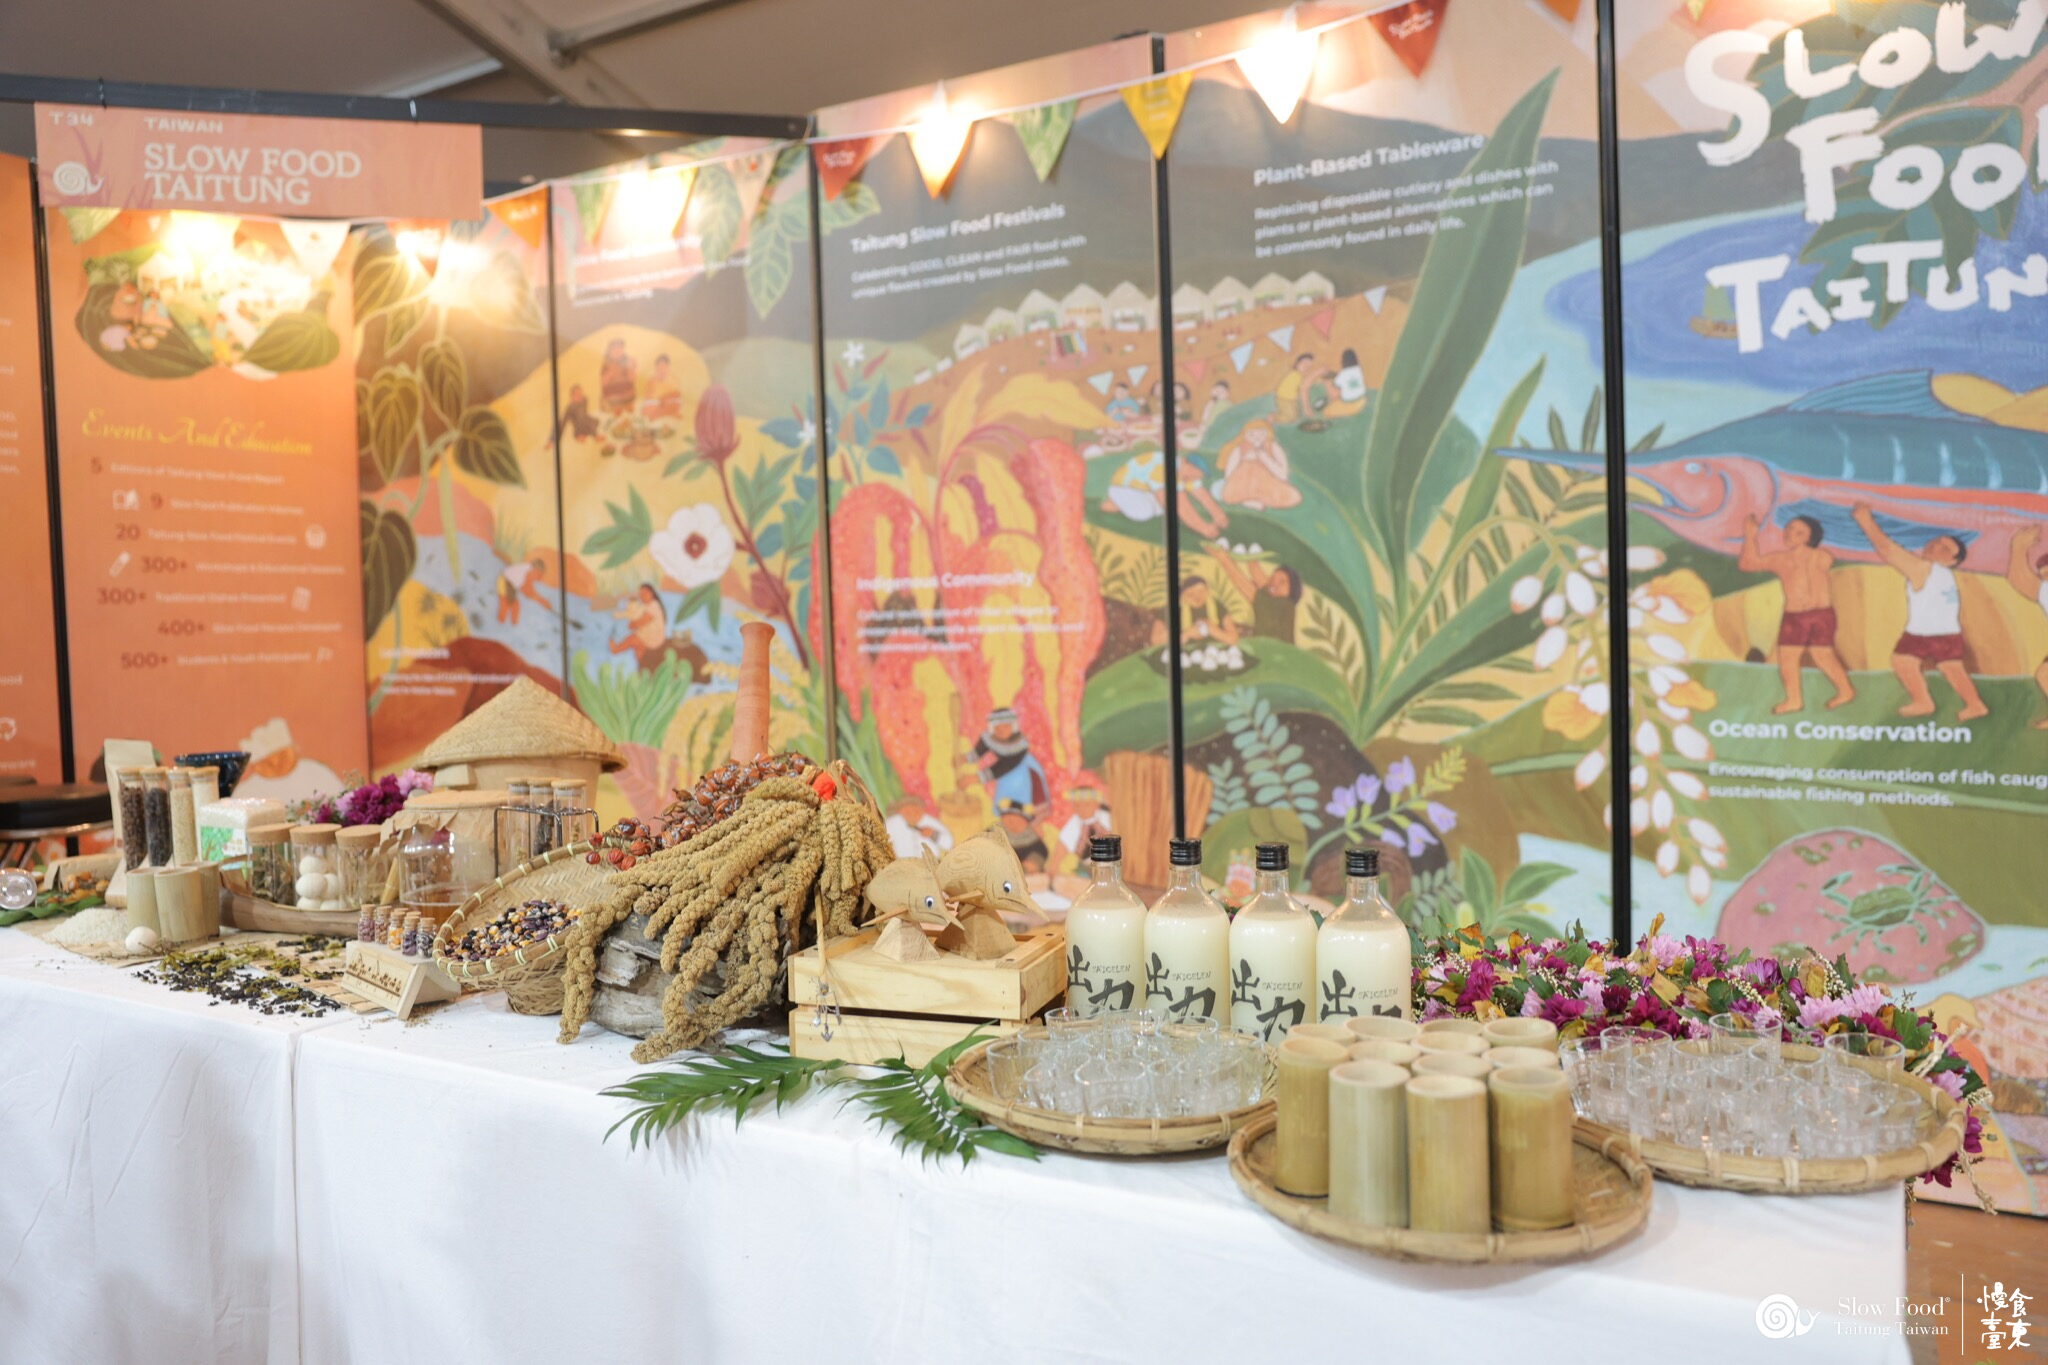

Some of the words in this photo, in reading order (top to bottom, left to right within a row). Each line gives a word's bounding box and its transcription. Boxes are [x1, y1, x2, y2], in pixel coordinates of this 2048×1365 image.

[1684, 0, 2047, 167] SLOW
[144, 116, 224, 134] TAIWAN
[144, 142, 250, 174] SLOW
[260, 147, 362, 178] FOOD
[1253, 149, 1373, 187] Plant-Based
[1375, 134, 1485, 166] Tableware
[1785, 107, 2048, 224] FOO
[144, 172, 312, 206] TAITUNG
[1254, 201, 1319, 220] Replacing
[1320, 188, 1392, 210] disposable
[1393, 181, 1442, 198] cutlery
[1444, 174, 1473, 189] and
[1474, 168, 1522, 185] dishes
[1524, 159, 1559, 177] with
[1255, 222, 1295, 241] plants
[1296, 220, 1312, 233] or
[1312, 205, 1393, 232] plant-based
[1394, 195, 1477, 217] alternatives
[1478, 186, 1524, 204] which
[1525, 183, 1554, 198] can
[850, 231, 909, 254] Taitung
[910, 225, 949, 244] Slow
[950, 213, 991, 237] Food
[993, 201, 1066, 231] Festivals
[1255, 245, 1273, 258] be
[1274, 234, 1342, 256] commonly
[1345, 225, 1386, 244] found
[1387, 224, 1402, 238] in
[1403, 219, 1437, 236] daily
[978, 265, 1004, 281] Slow
[1005, 260, 1034, 275] Food
[82, 407, 152, 441] Events
[158, 416, 232, 448] And
[115, 523, 141, 541] 20
[141, 555, 187, 573] 300+
[941, 570, 1036, 589] Community
[97, 587, 147, 605] 300+
[158, 619, 205, 636] 400+
[121, 652, 168, 669] 500+
[1708, 719, 1788, 739] Ocean
[1794, 720, 1972, 743] Conservation
[1708, 761, 1814, 782] Encouraging
[1816, 767, 1934, 784] consumption
[1938, 769, 1958, 784] of
[1961, 769, 1995, 785] fish
[1708, 785, 1802, 800] sustainable
[1805, 786, 1865, 806] fishing
[1869, 791, 1954, 807] methods.
